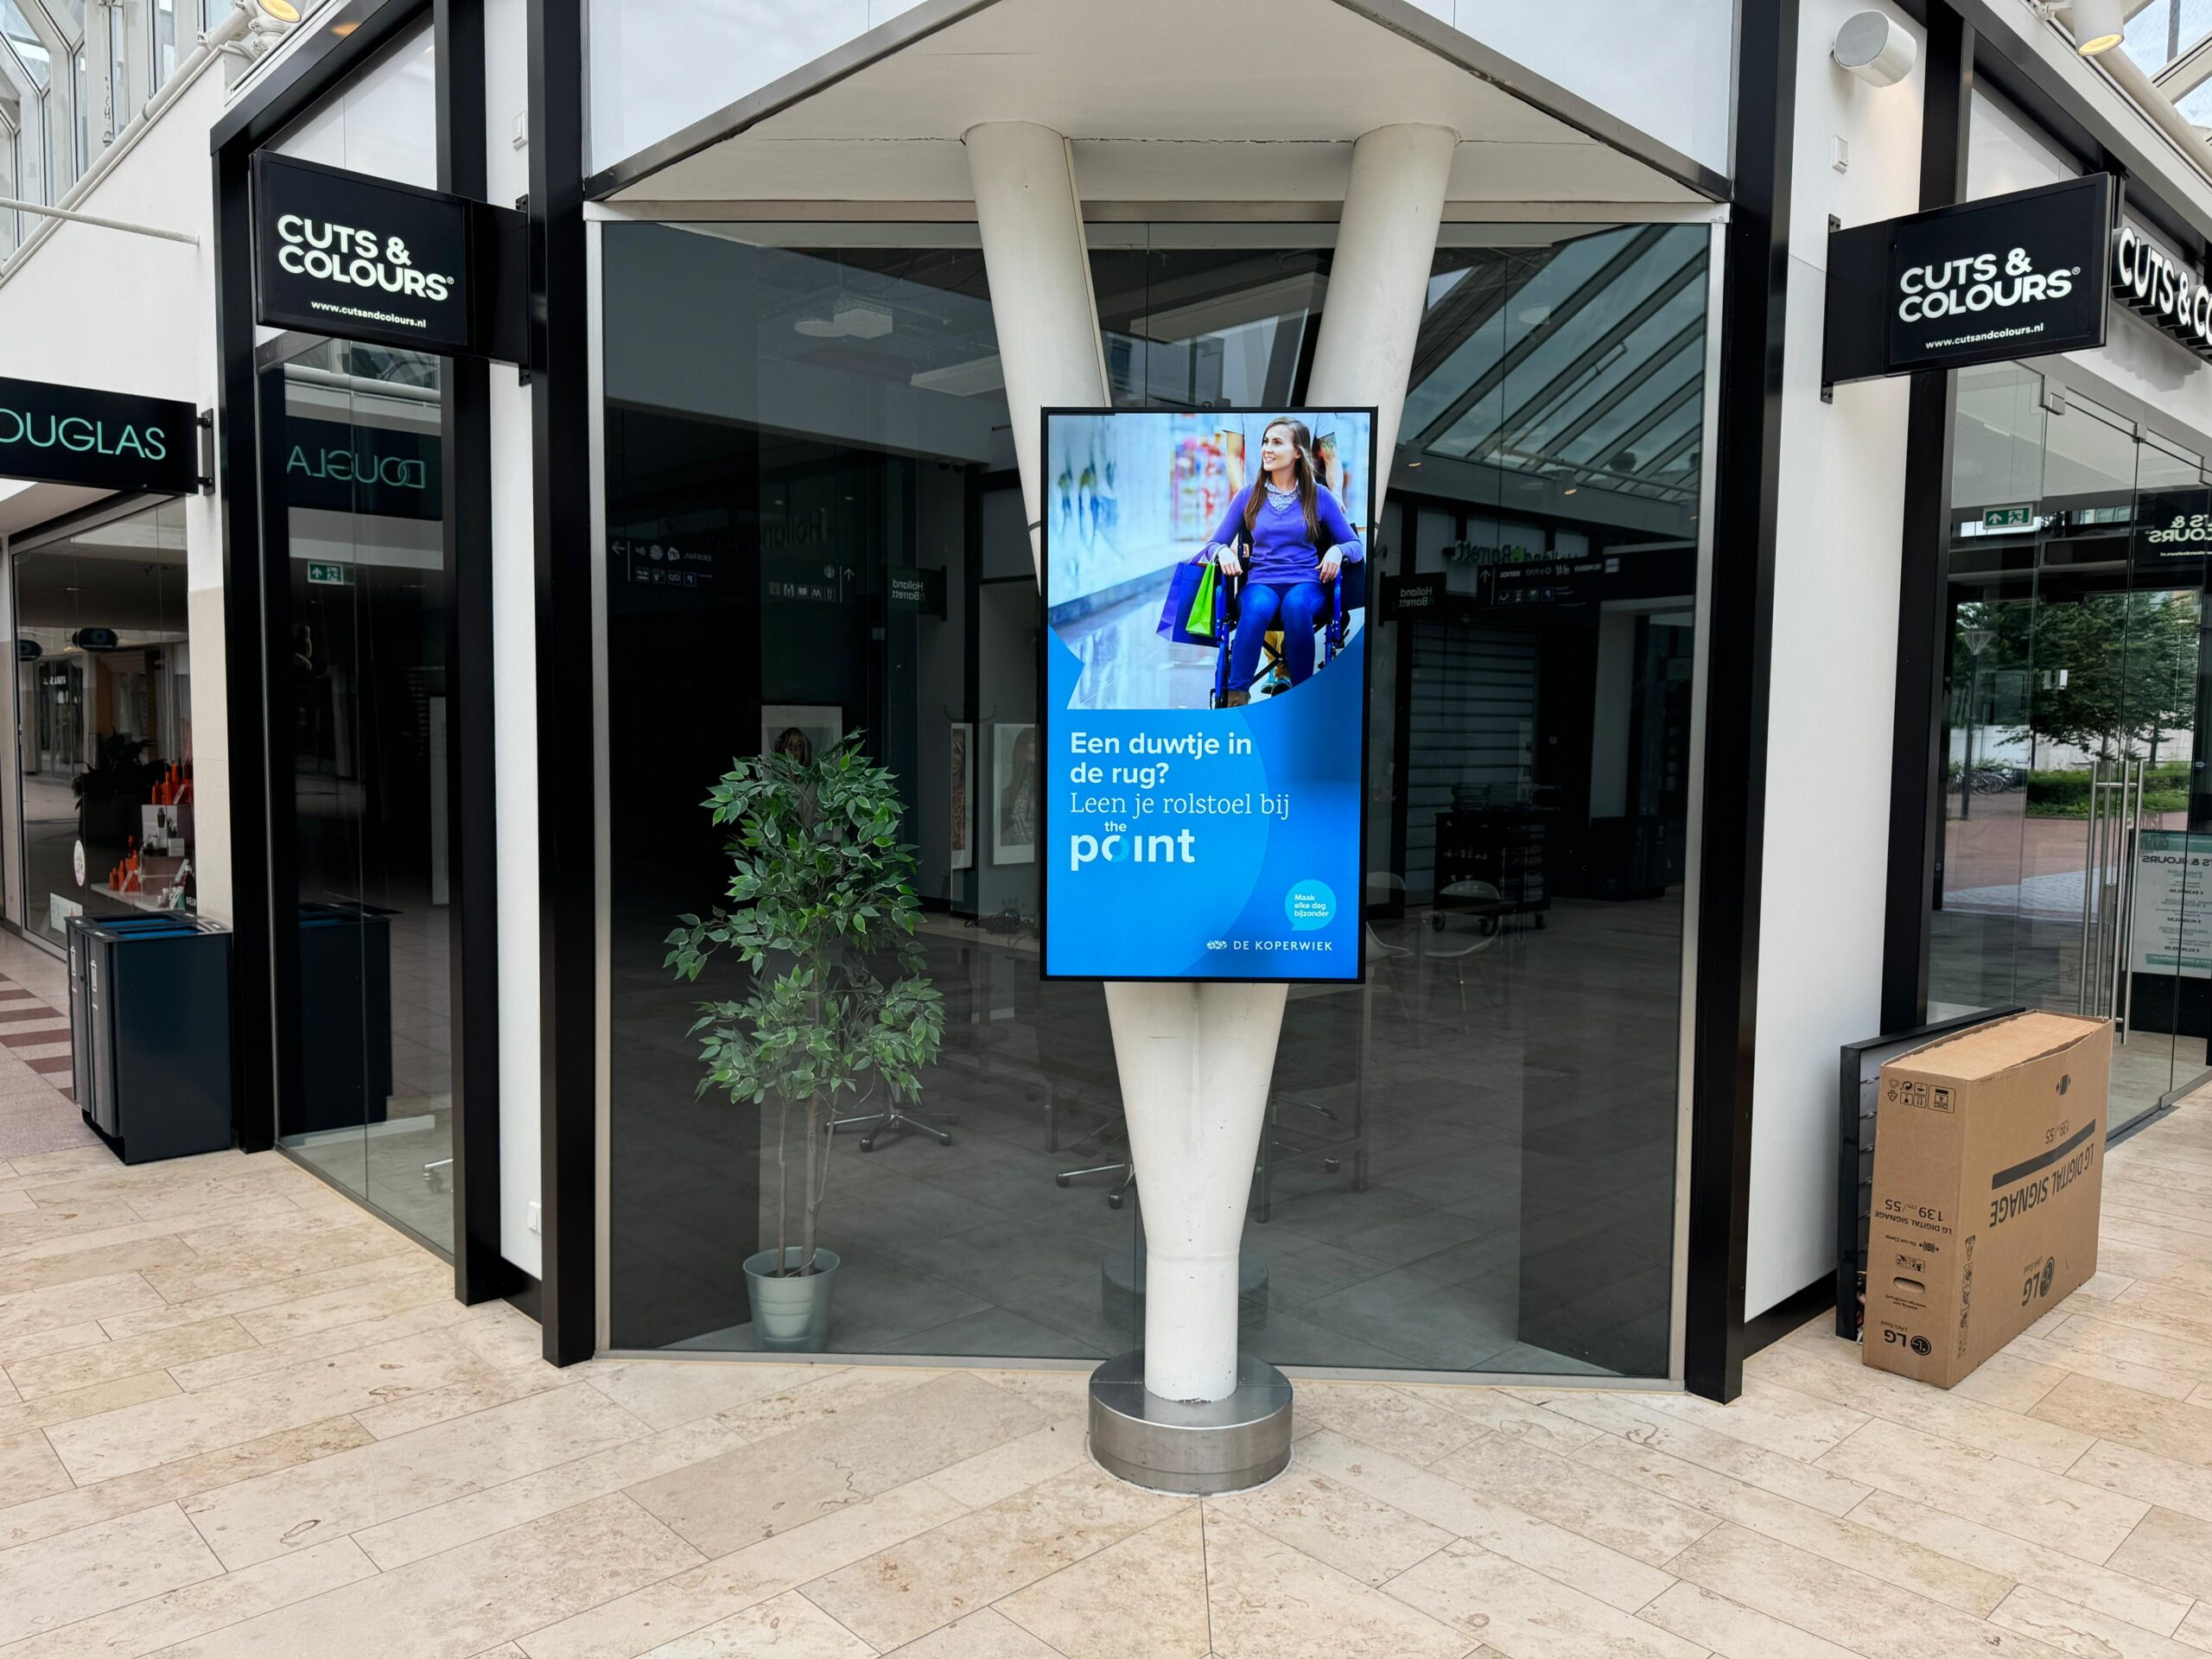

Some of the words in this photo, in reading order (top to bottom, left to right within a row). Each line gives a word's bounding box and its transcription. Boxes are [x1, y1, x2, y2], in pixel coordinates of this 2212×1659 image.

[277, 213, 378, 259] CUTS
[385, 235, 412, 265] &
[1899, 252, 1998, 294] CUTS
[2005, 246, 2033, 276] &
[2119, 226, 2176, 315] CUTS
[2177, 270, 2191, 327] &
[310, 300, 427, 329] www.cutsandcolours.nl
[1925, 322, 2044, 350] www.cutsandcolours.nl
[0, 408, 167, 461] OUGLAS
[1070, 732, 1120, 754] Een
[1128, 733, 1219, 760] duwtje
[1229, 733, 1252, 754] in
[1070, 762, 1103, 784] de
[1112, 761, 1170, 789] rug?
[1070, 792, 1127, 814] Leen
[1132, 792, 1154, 820] je
[1162, 793, 1252, 815] rolstoel
[1261, 794, 1290, 820] bij
[1104, 821, 1127, 832] the
[1071, 829, 1196, 872] point
[1294, 909, 1330, 918] bijzonder
[1312, 902, 1326, 911] dag
[1233, 940, 1249, 950] DE
[1255, 940, 1333, 951] KOPERWIEK
[2084, 1142, 2094, 1170] LG
[2050, 1150, 2084, 1195] DIGITAL
[1873, 1210, 1909, 1225] SIGNAGE
[1918, 1206, 1943, 1222] 139
[1989, 1179, 2049, 1229] SIGNAGE
[1885, 1234, 1900, 1243] Clamp
[1910, 1217, 1941, 1232] DIGITAL
[1942, 1226, 1952, 1235] LG
[2023, 1260, 2034, 1275] Good
[2021, 1271, 2041, 1307] LG
[1880, 1320, 1894, 1329] Good
[1884, 1329, 1907, 1347] LG
[1894, 1324, 1908, 1333] Life's
